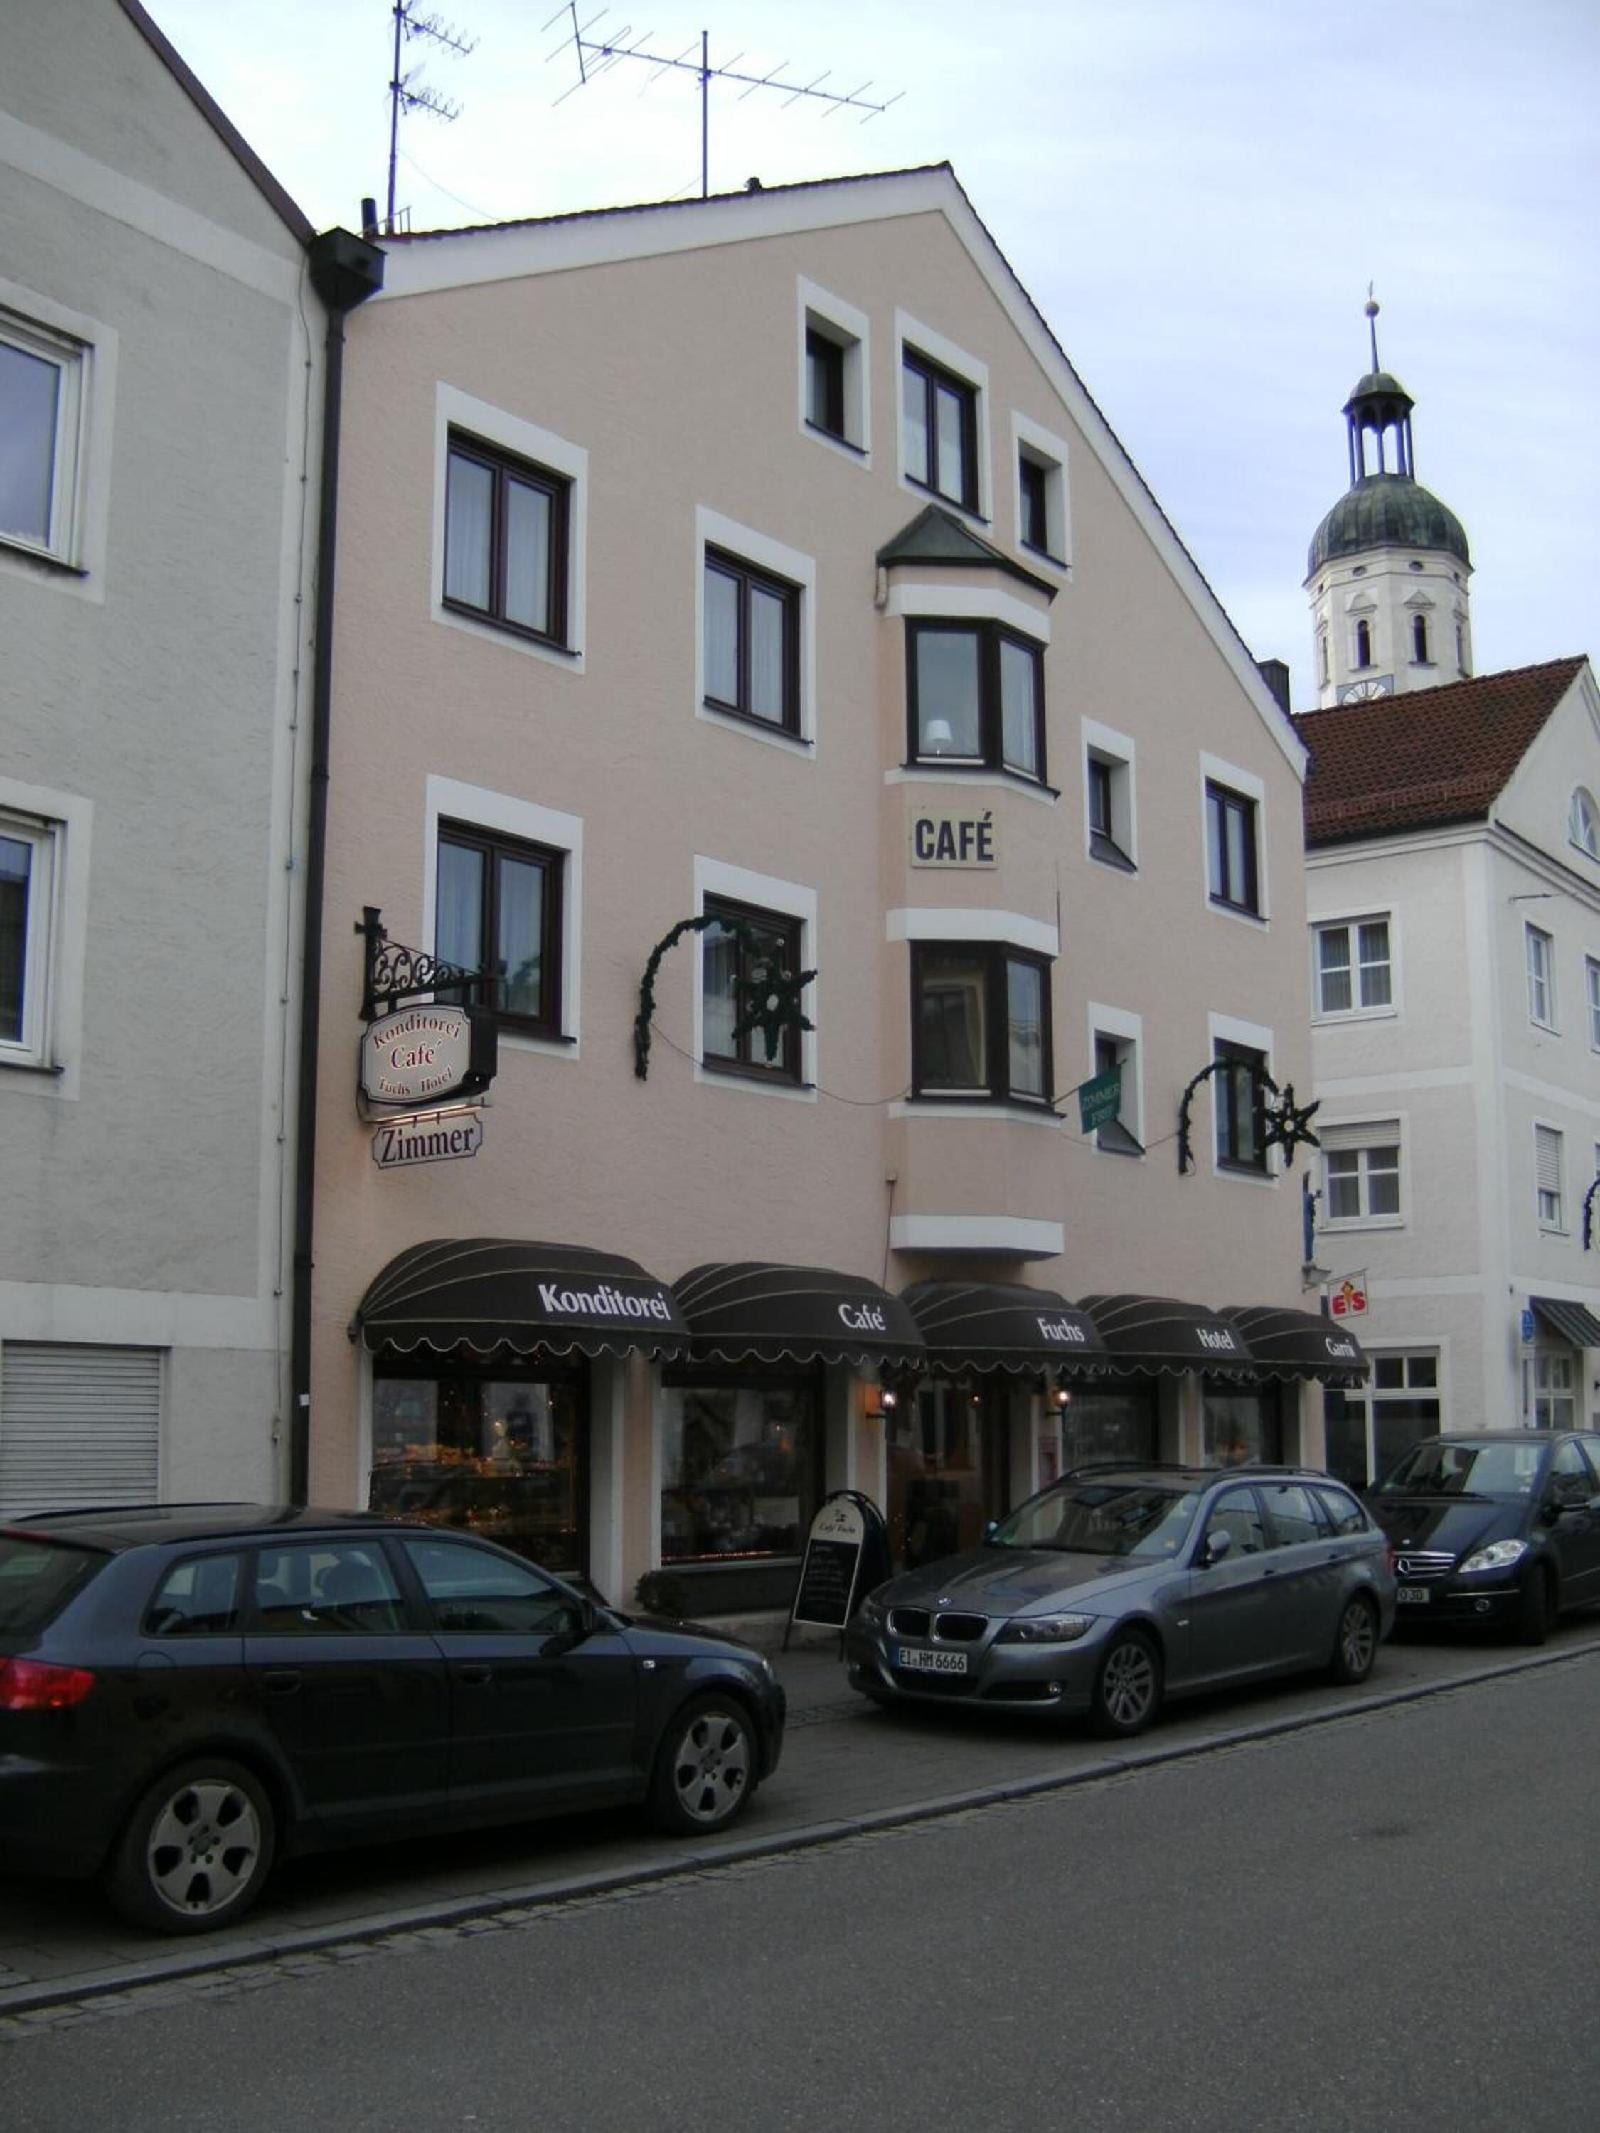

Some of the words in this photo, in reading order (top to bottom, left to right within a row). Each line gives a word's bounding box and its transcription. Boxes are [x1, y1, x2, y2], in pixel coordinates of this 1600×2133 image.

[915, 811, 993, 861] CAFÉ
[373, 1013, 461, 1049] Konditorei
[391, 1040, 442, 1069] Café
[421, 1067, 452, 1092] Hotel
[381, 1127, 474, 1162] Zimmer
[538, 1284, 671, 1320] Konditorei
[838, 1304, 886, 1331] Café
[1036, 1317, 1084, 1342] Fuchs
[1196, 1328, 1235, 1350] Hotel
[935, 1653, 965, 1670] 6666
